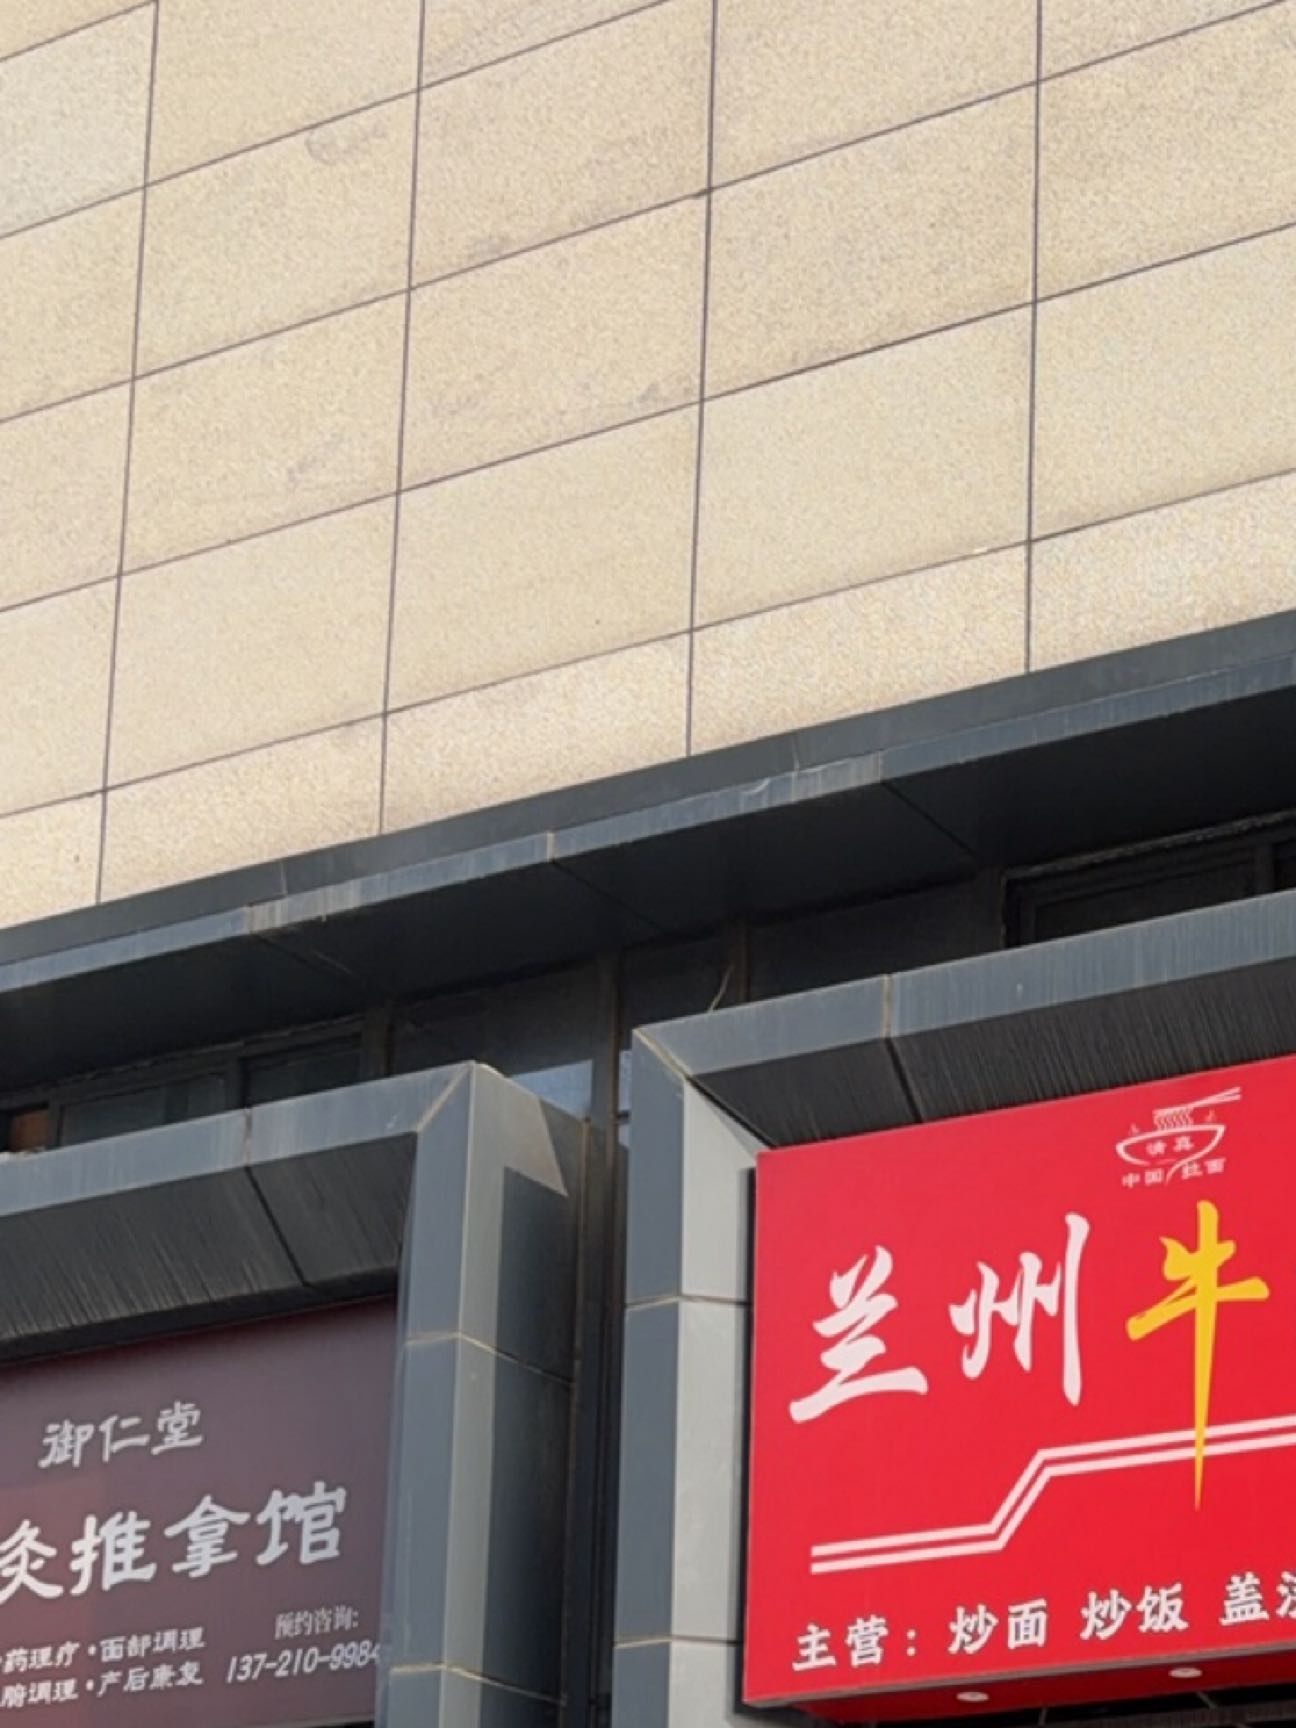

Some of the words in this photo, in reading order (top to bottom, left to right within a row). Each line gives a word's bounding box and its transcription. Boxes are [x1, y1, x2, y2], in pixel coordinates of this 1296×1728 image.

[38, 1400, 203, 1468] 御仁堂
[792, 1614, 917, 1672] 主营：
[948, 1599, 1050, 1656] 炒面
[1080, 1582, 1190, 1641] 炒饭
